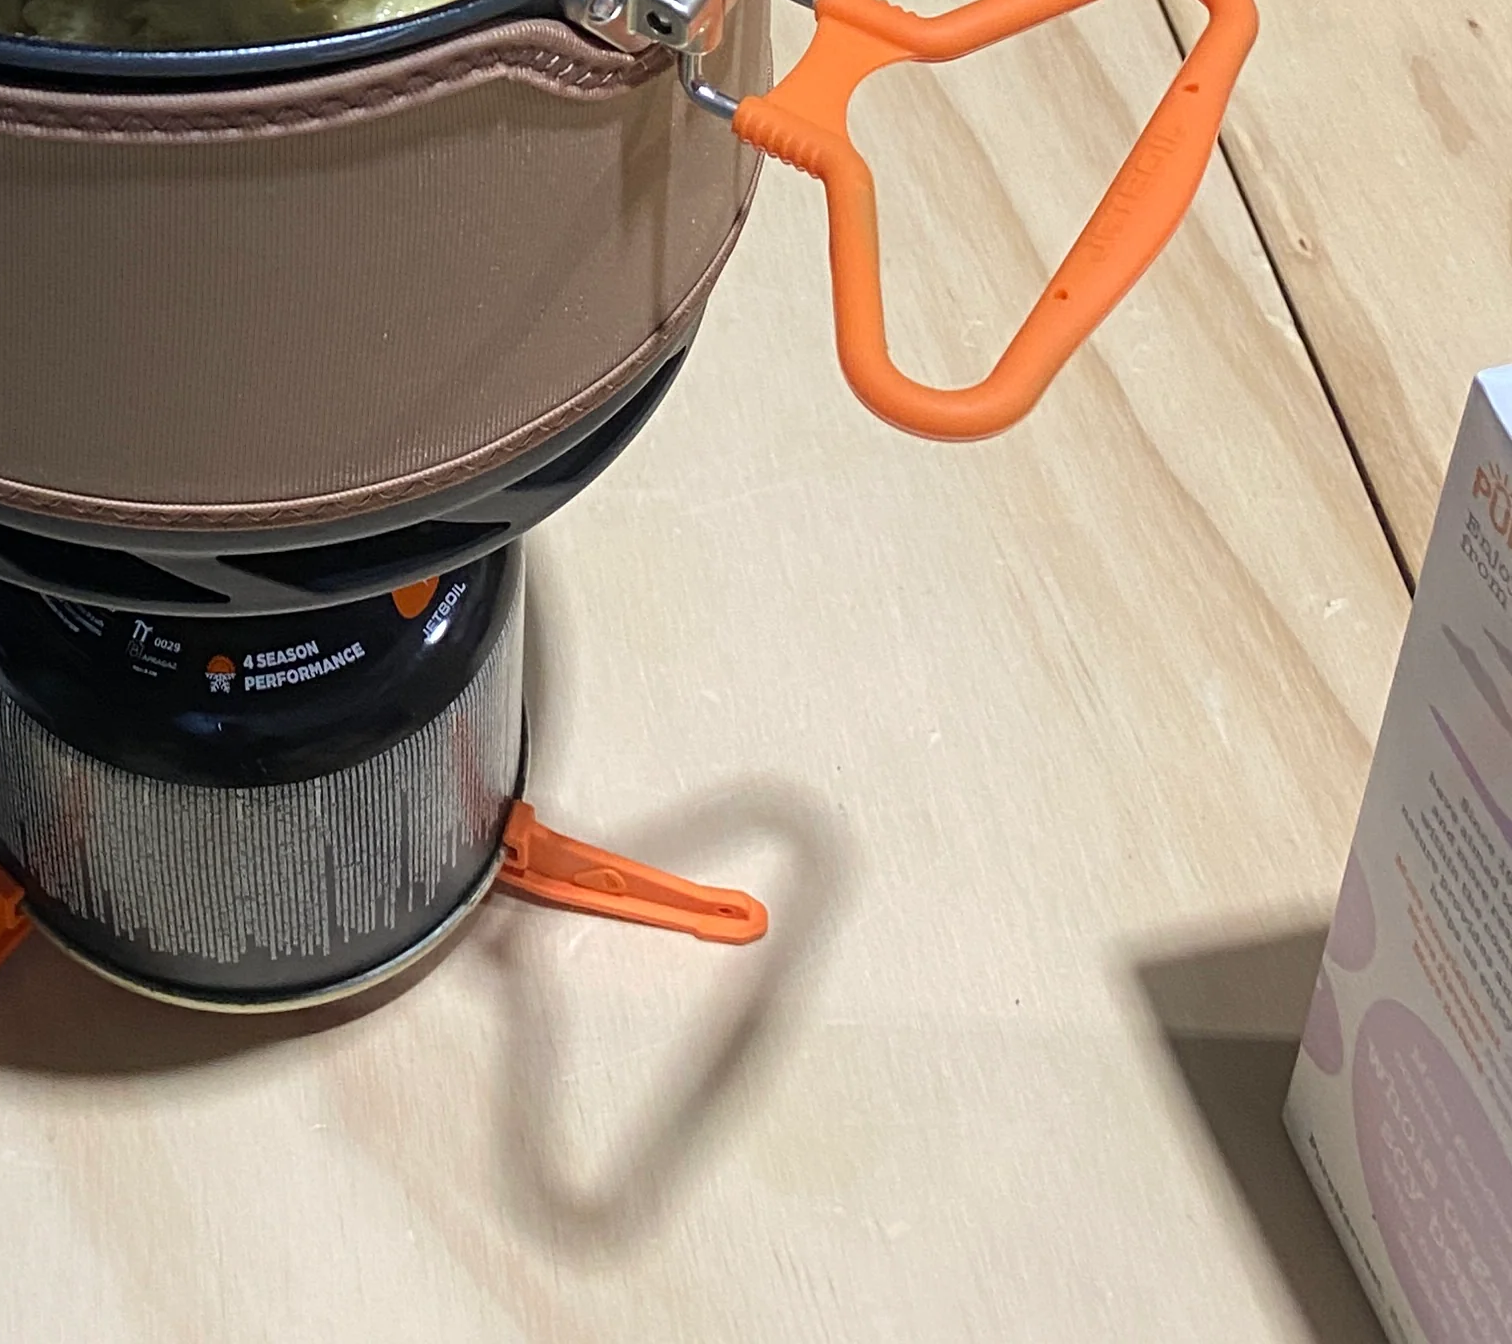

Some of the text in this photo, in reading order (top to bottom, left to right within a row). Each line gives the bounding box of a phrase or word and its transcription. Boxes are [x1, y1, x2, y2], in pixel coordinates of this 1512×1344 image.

[1467, 509, 1512, 596] Enjo
[422, 581, 467, 643] JETBOIL
[154, 637, 181, 653] 0029
[243, 639, 320, 670] 4 SEASON
[244, 641, 366, 692] PERFORMANCE
